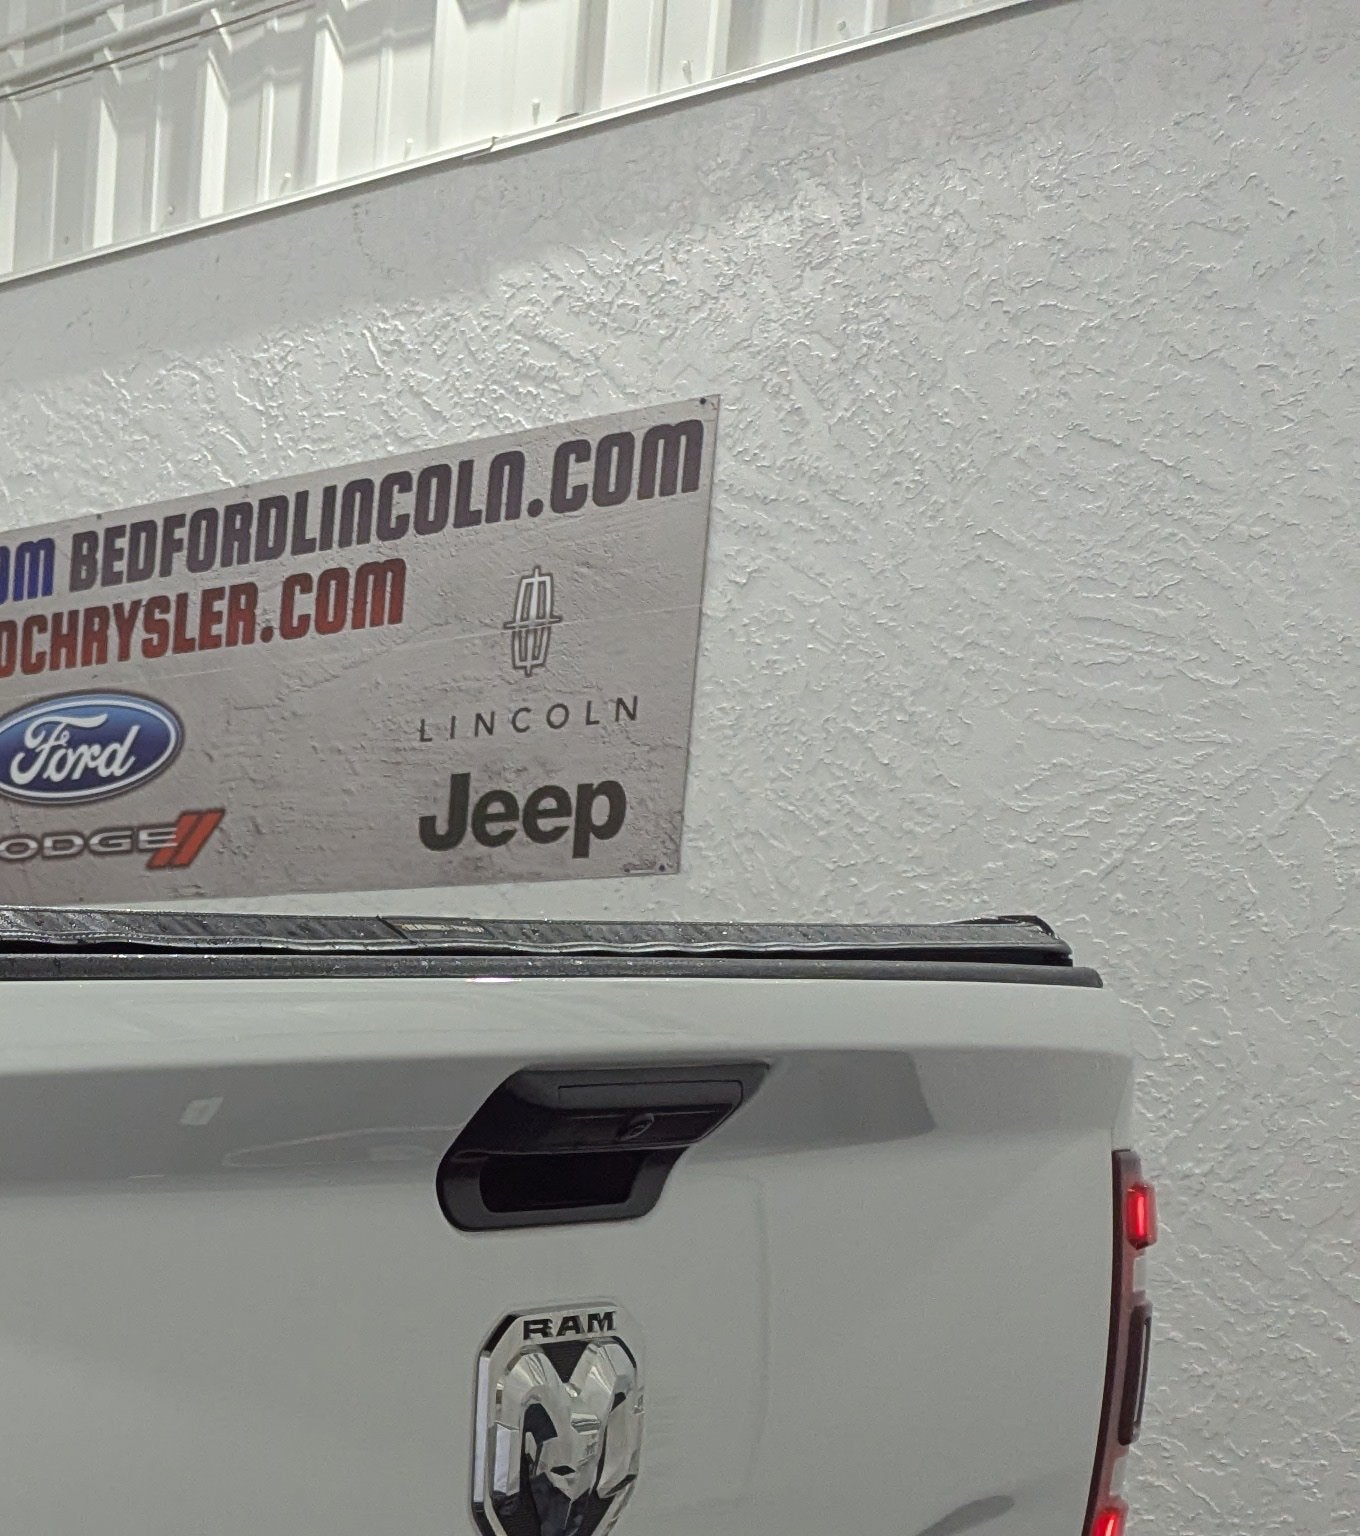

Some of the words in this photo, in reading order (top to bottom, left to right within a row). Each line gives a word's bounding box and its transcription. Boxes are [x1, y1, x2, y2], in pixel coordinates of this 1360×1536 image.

[68, 419, 705, 593] BEDFORDLINCOLN.COM
[9, 712, 142, 786] Ford
[418, 695, 639, 743] LINCOLN
[418, 772, 628, 860] Jeep
[522, 1310, 617, 1341] RAM
